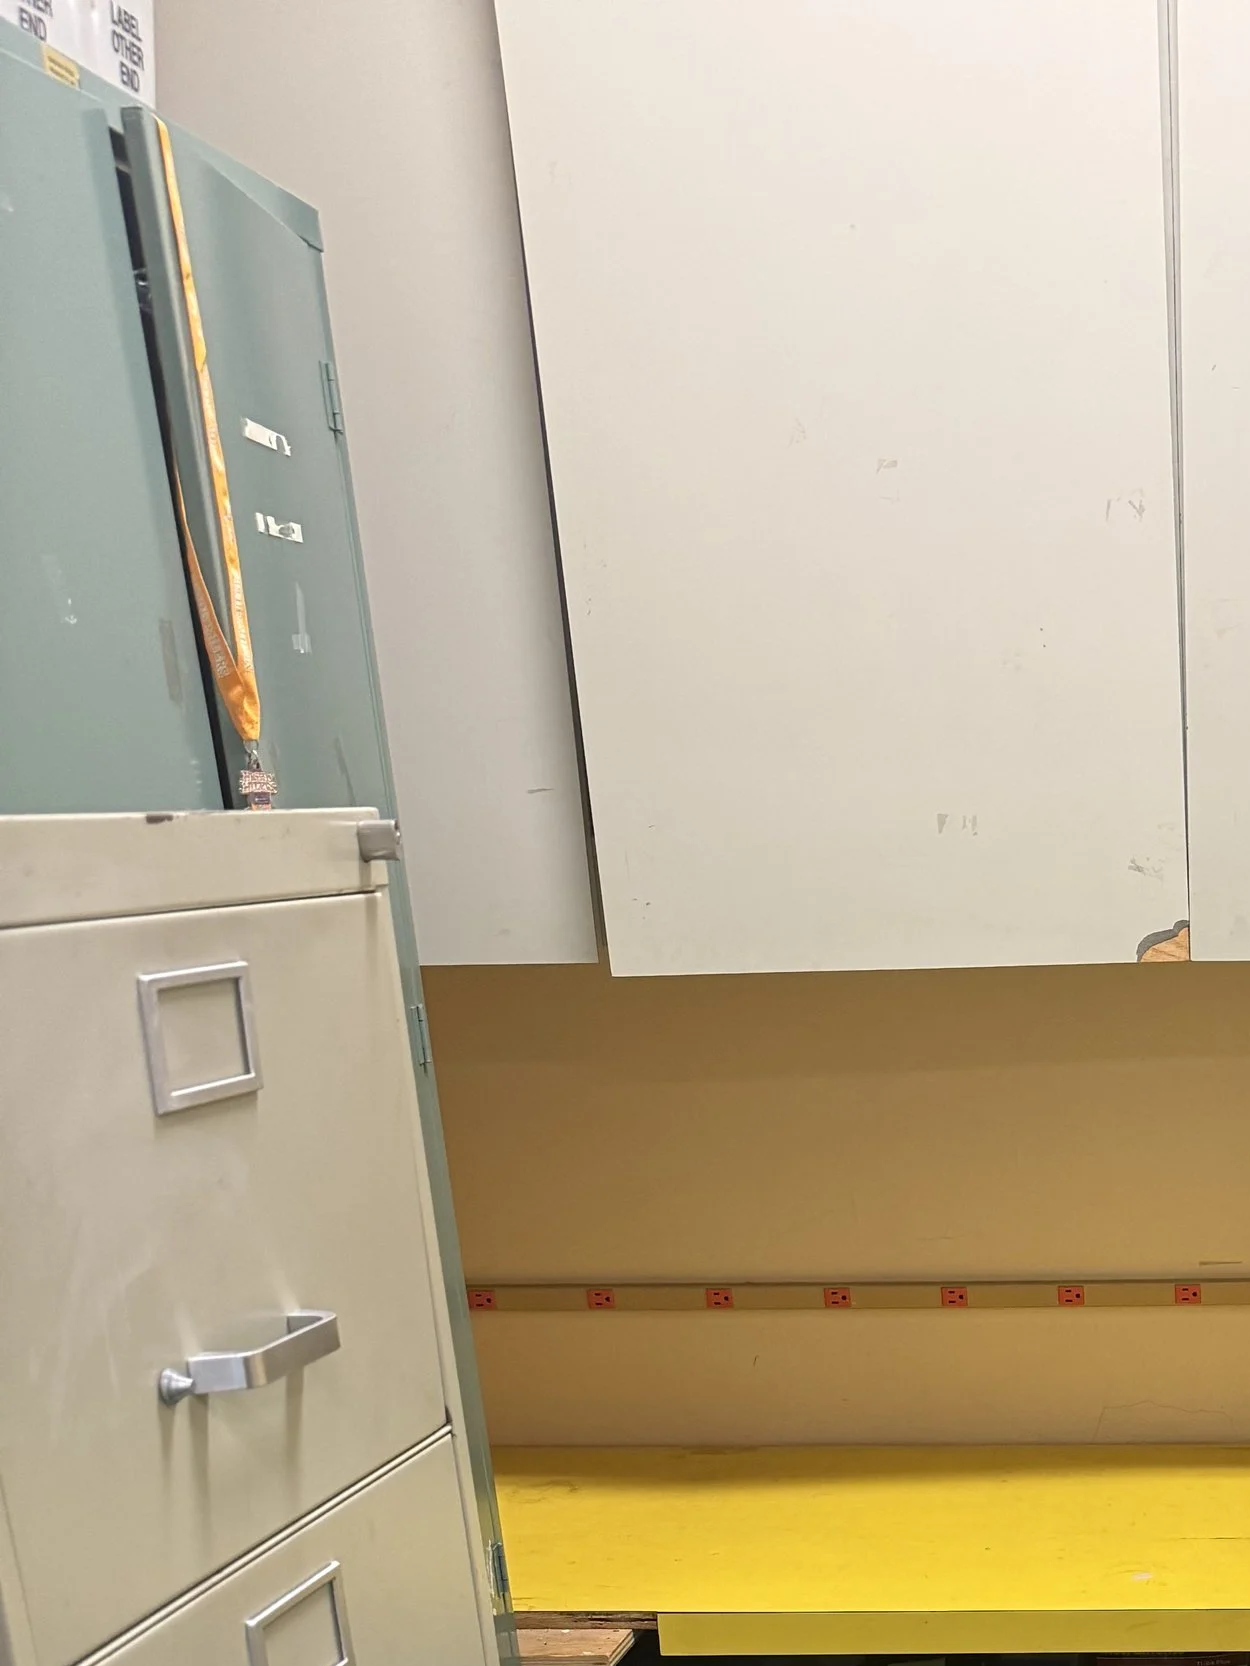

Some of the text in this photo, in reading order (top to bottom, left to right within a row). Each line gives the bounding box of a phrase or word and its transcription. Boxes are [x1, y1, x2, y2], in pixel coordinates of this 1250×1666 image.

[19, 6, 47, 42] END
[110, 0, 142, 42] LABEL
[112, 29, 145, 71] OTHER
